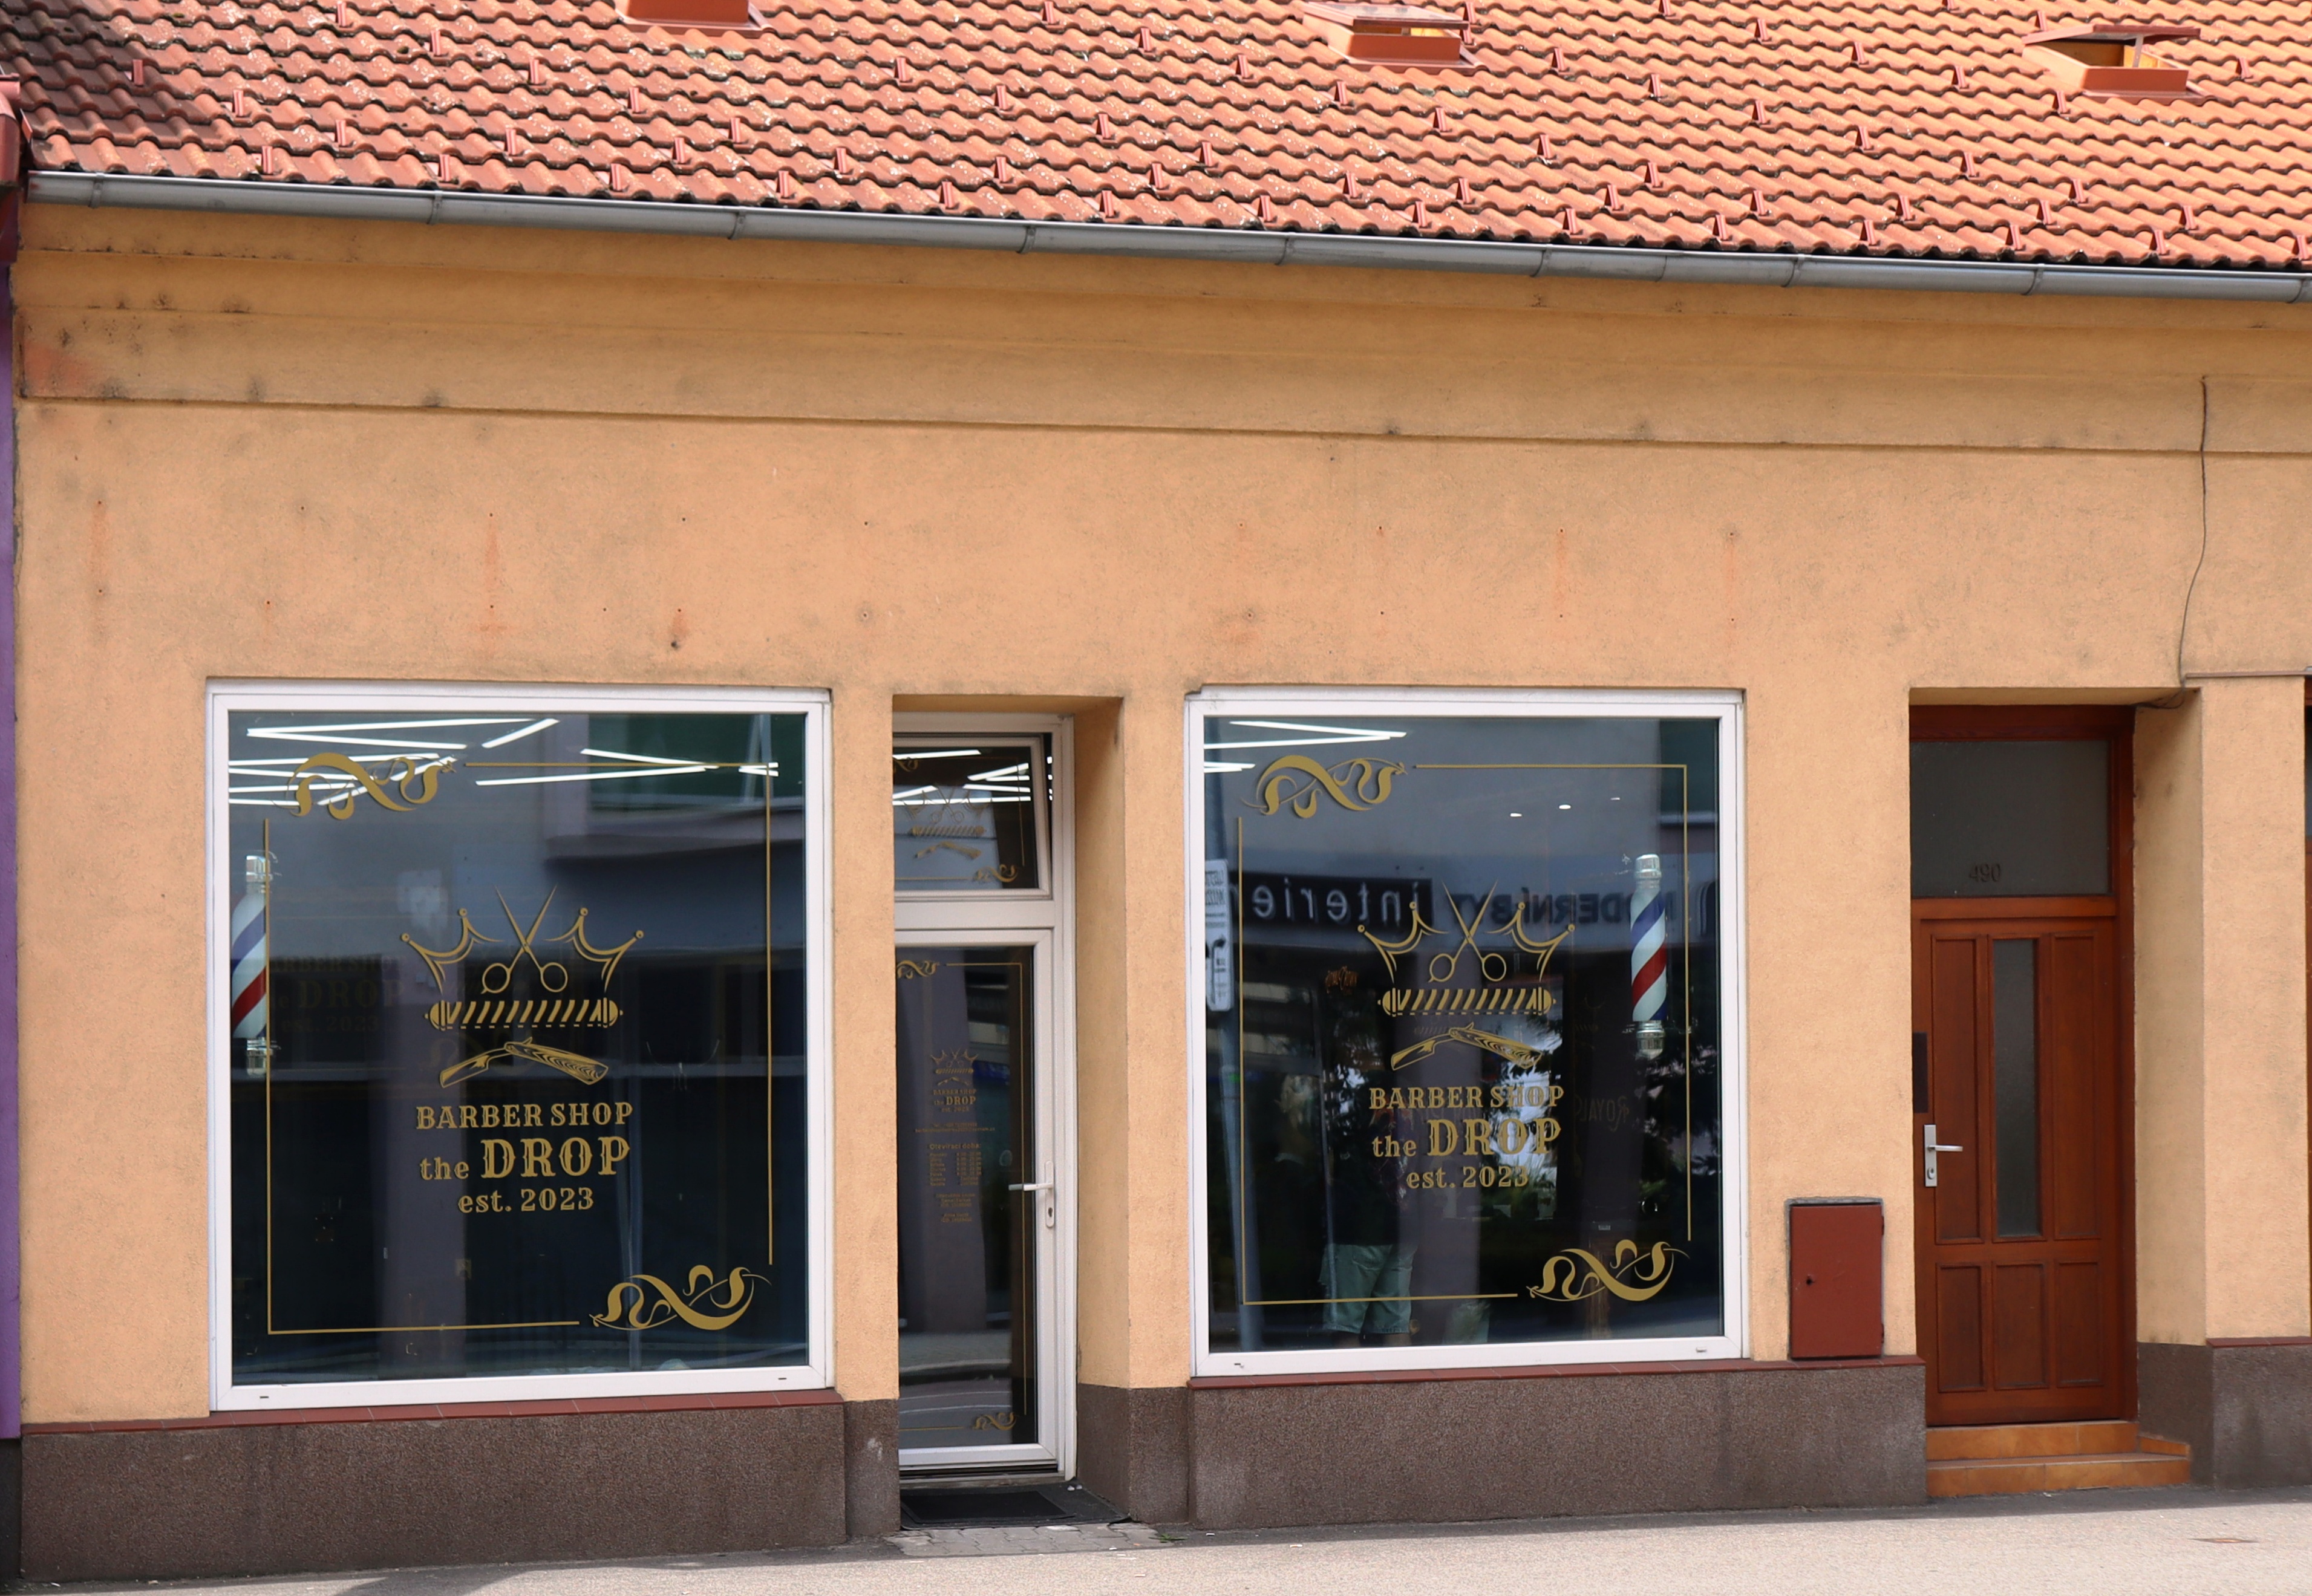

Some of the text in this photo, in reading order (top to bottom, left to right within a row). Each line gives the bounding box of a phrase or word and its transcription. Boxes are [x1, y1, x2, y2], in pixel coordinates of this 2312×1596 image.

[1968, 863, 2000, 882] 490
[946, 1096, 976, 1106] DROP
[1369, 1086, 1484, 1109] BARBER
[1490, 1086, 1564, 1108] SHOP
[416, 1102, 633, 1130] BARBER SHOP
[1372, 1118, 1561, 1158] the DROP
[420, 1136, 630, 1180] the DROP
[1406, 1165, 1529, 1189] est. 2023
[458, 1187, 594, 1213] est. 2023
